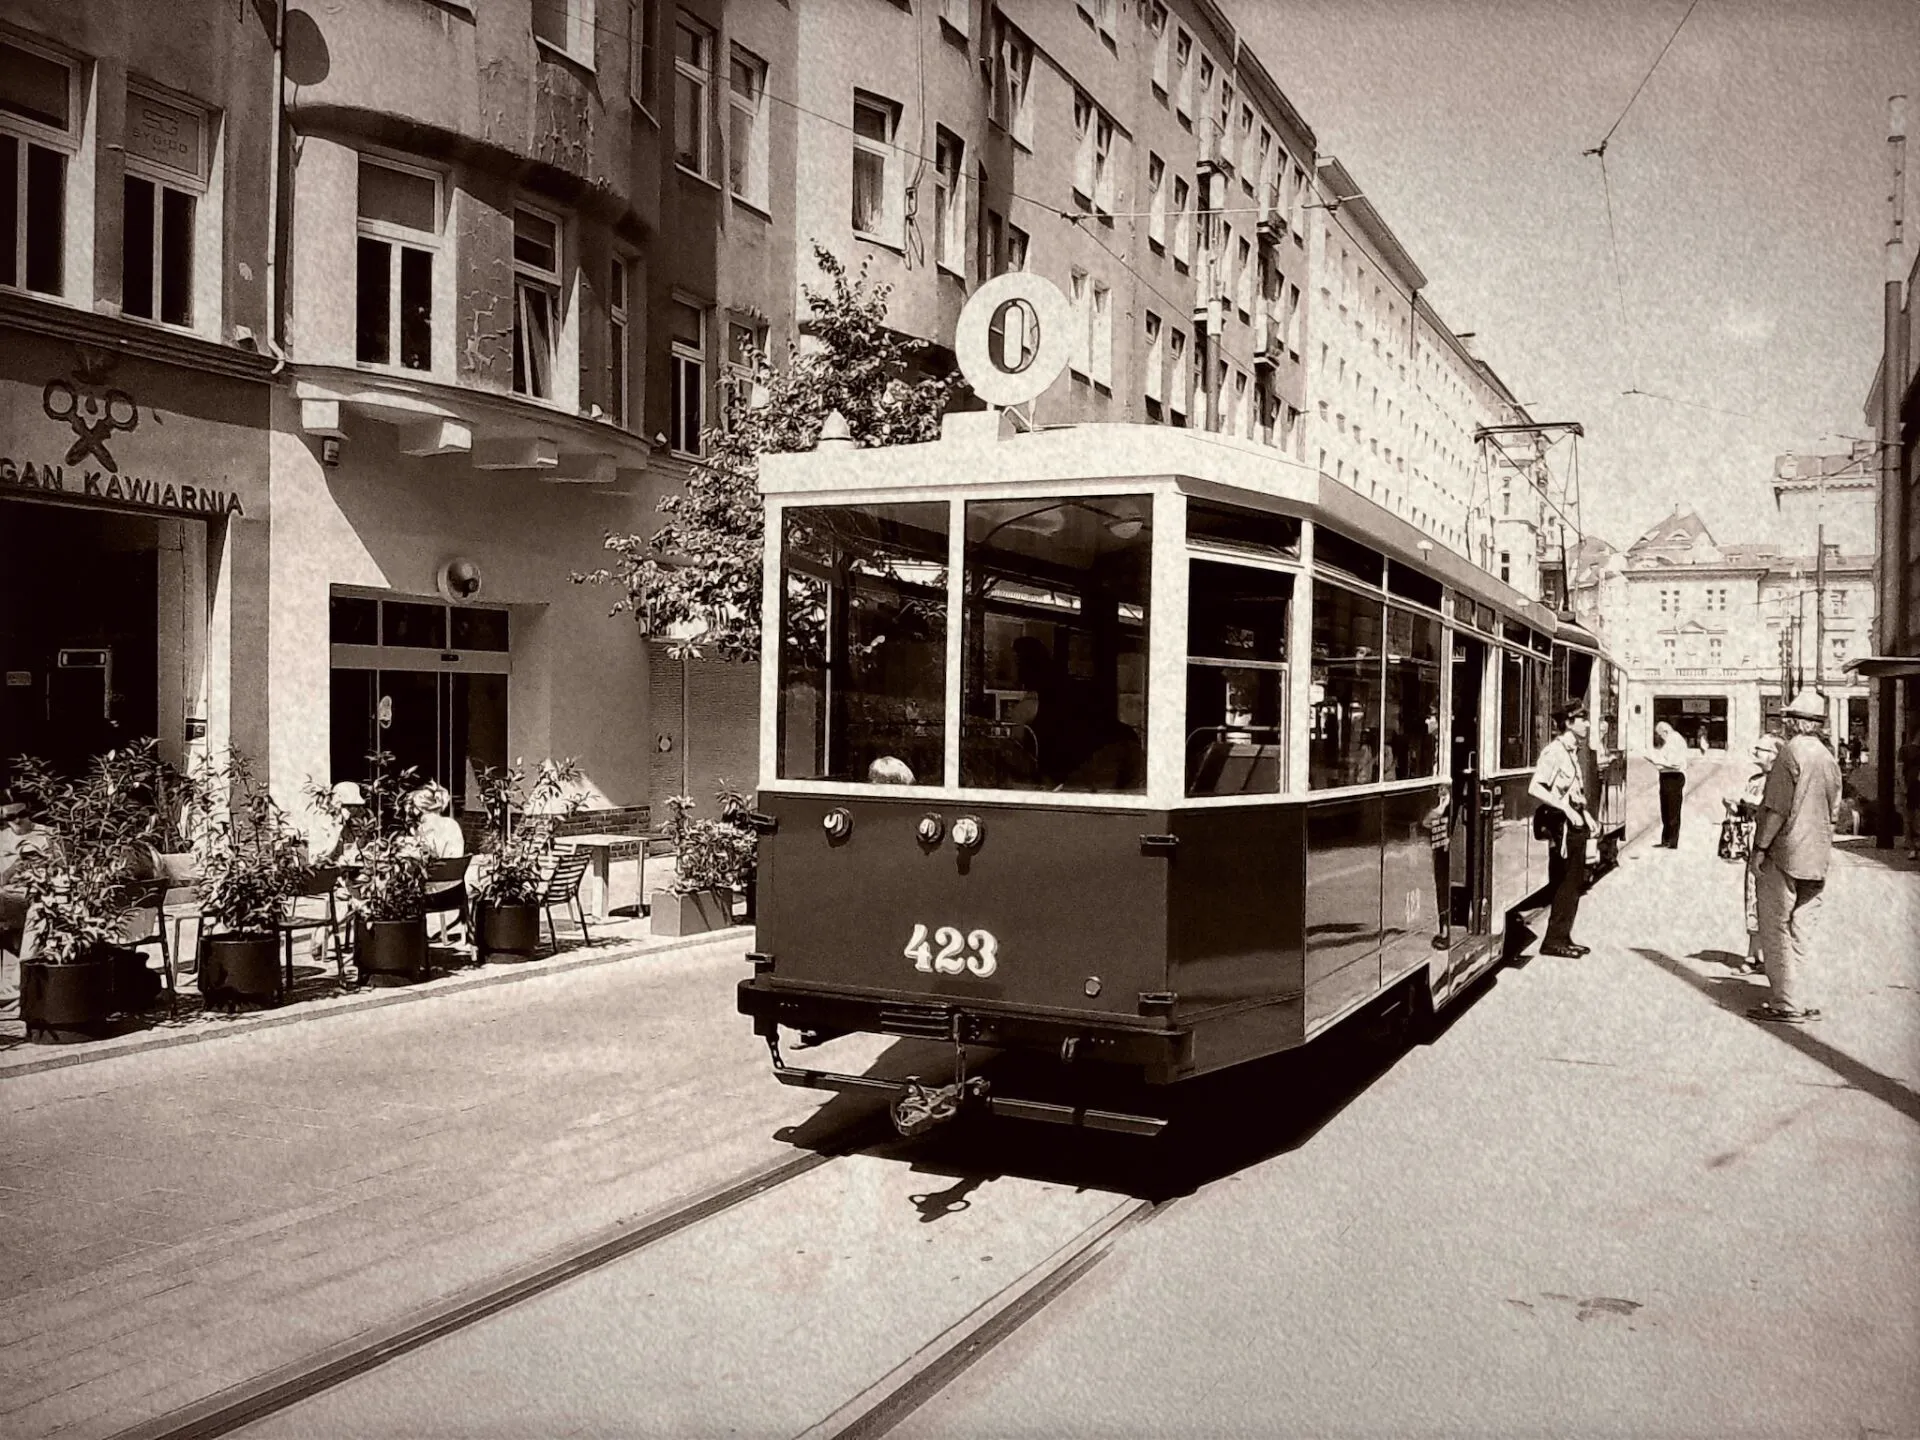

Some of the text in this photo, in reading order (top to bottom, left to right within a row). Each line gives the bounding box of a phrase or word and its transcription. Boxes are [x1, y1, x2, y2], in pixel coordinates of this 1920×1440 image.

[0, 457, 244, 517] GAN KAWIARNIA
[903, 924, 998, 978] 423
